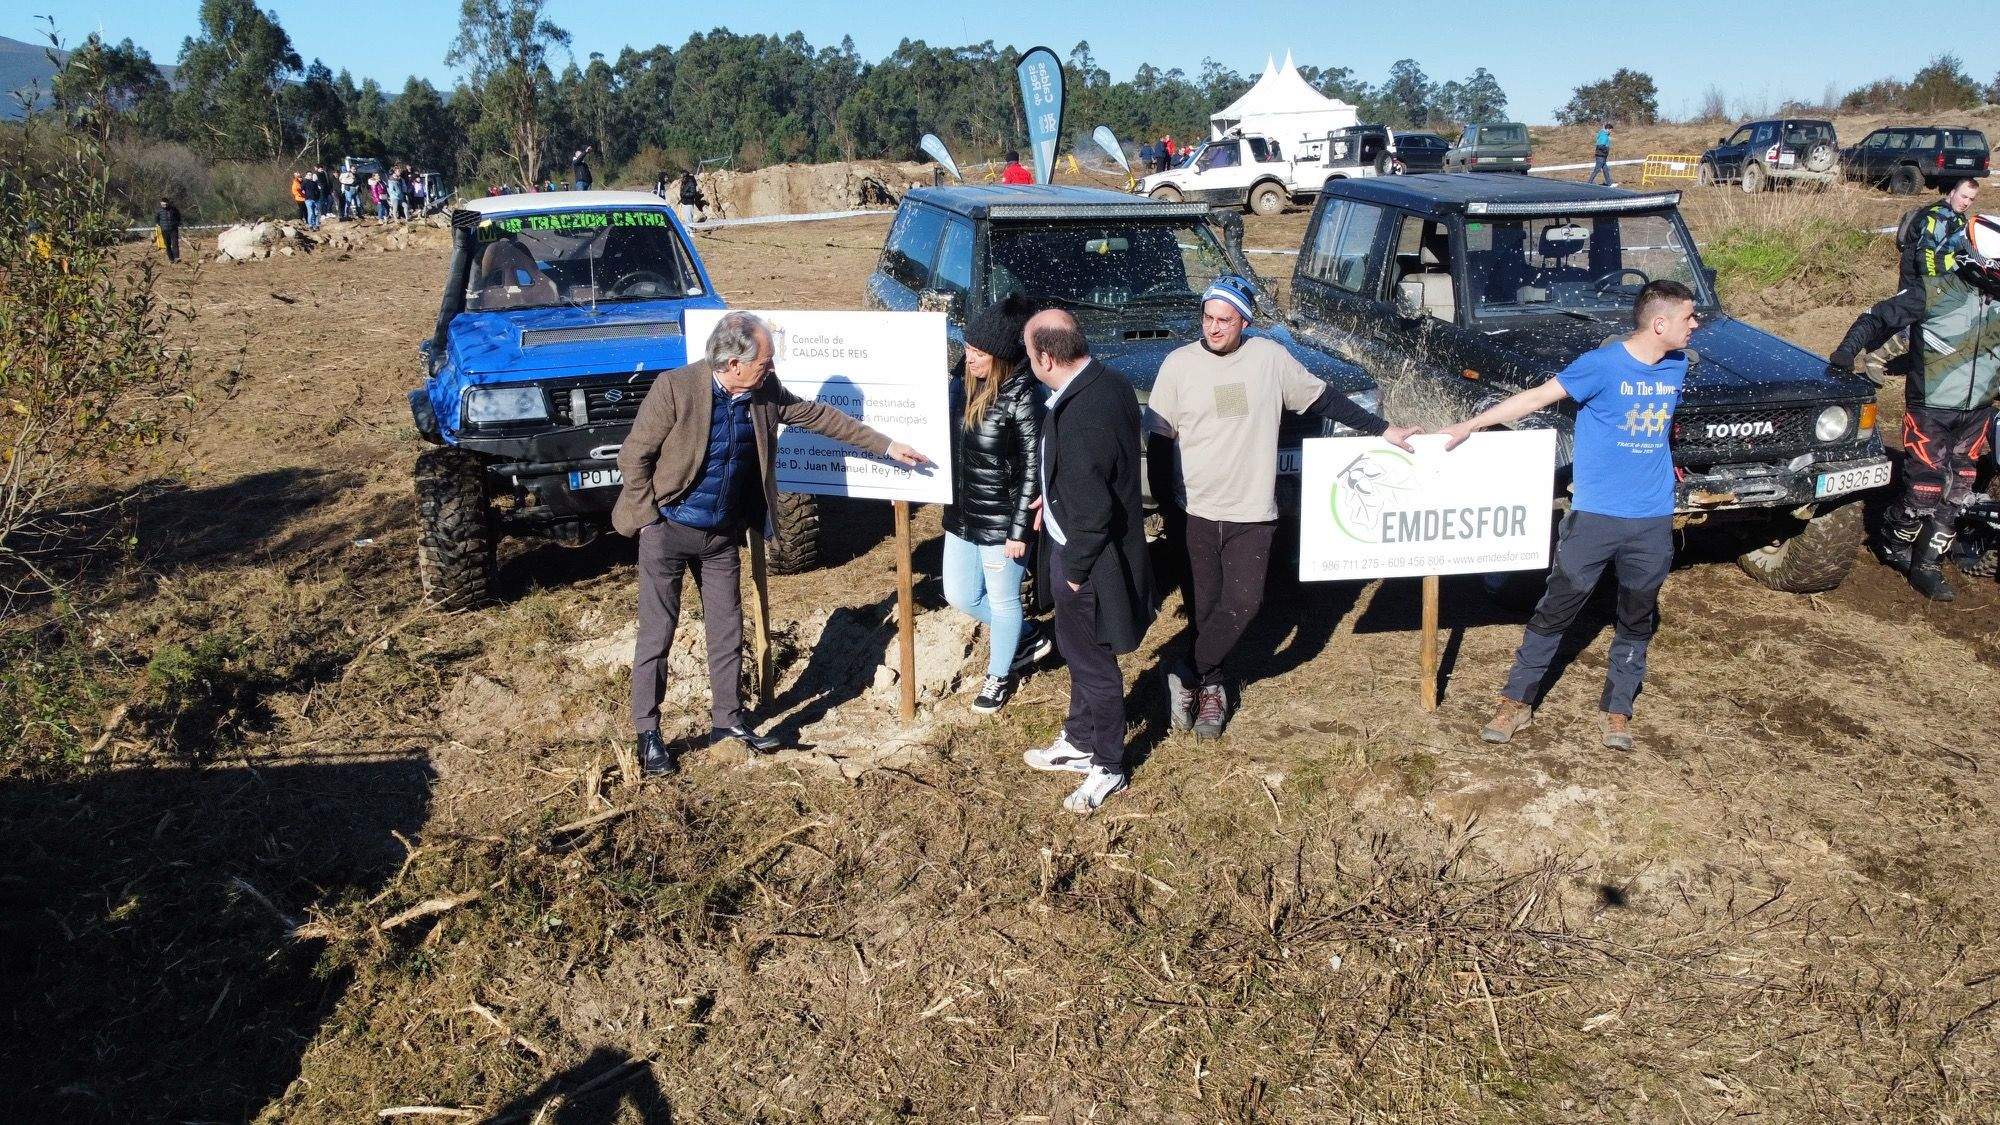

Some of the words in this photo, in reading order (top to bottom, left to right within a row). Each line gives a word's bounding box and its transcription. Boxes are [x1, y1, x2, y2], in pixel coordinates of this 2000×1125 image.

[792, 334, 829, 345] Concello
[833, 335, 844, 345] de
[792, 348, 829, 358] CALDAS
[833, 349, 845, 358] DE
[848, 349, 868, 359] REIS
[1620, 380, 1634, 396] On
[1636, 380, 1653, 396] The
[1656, 381, 1676, 396] Move
[866, 396, 916, 408] destinada
[874, 413, 928, 426] municipais
[1706, 420, 1774, 439] TOYOTA
[793, 447, 806, 455] en
[808, 445, 858, 458] decembro
[861, 449, 874, 460] de
[790, 459, 801, 469] D.
[804, 461, 828, 472] Juan
[831, 462, 868, 473] Manuel
[871, 465, 890, 478] Rey
[893, 466, 913, 479] Rey
[1838, 469, 1870, 491] 3926
[1874, 465, 1889, 484] BS
[1382, 505, 1527, 544] EMDESFOR
[1343, 559, 1358, 570] 711
[1361, 558, 1379, 569] 275
